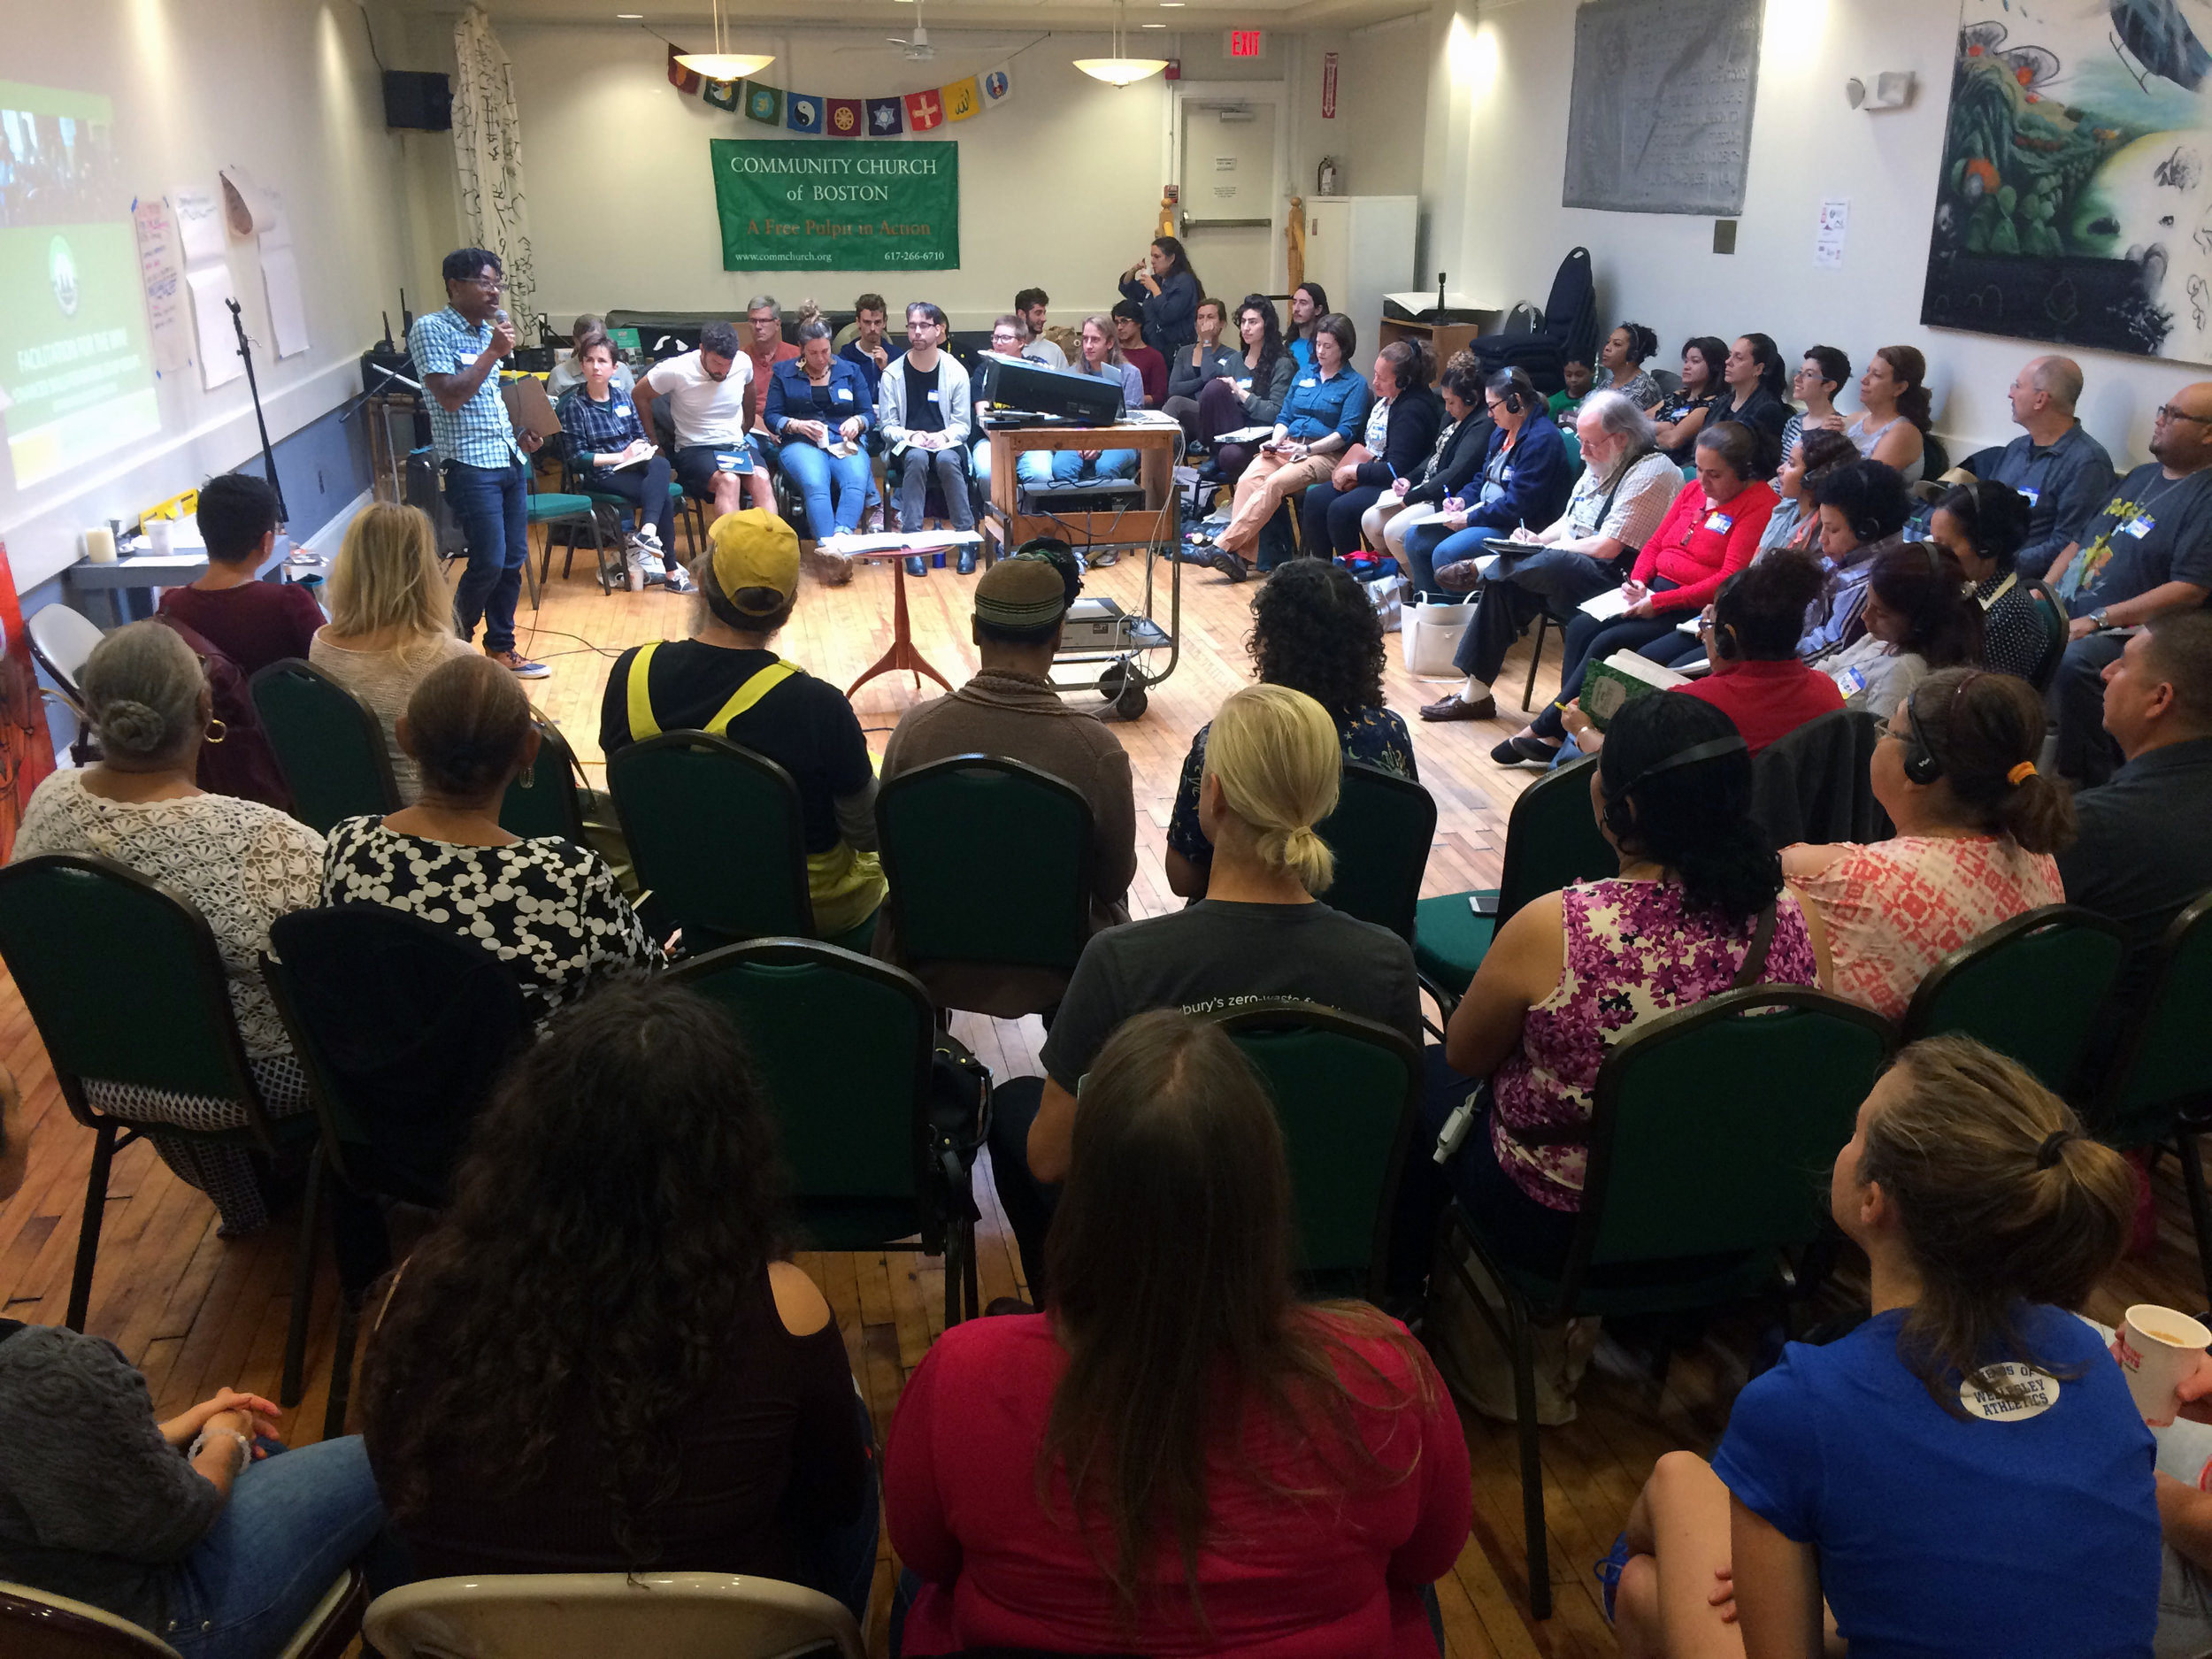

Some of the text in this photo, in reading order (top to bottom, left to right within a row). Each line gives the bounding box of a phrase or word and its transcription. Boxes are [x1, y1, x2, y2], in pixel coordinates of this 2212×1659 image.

[1232, 31, 1260, 56] EXIT
[731, 157, 937, 175] COMMUNITY CHURCH
[787, 185, 888, 201] of BOSTON
[747, 219, 932, 239] A Free Pulpit in Action
[735, 250, 945, 262] www.commchurch.org 617-266-6710
[1179, 997, 1225, 1016] bury's
[1974, 1379, 2045, 1403] WELESLEY
[1983, 1392, 2048, 1416] ATHLETICS
